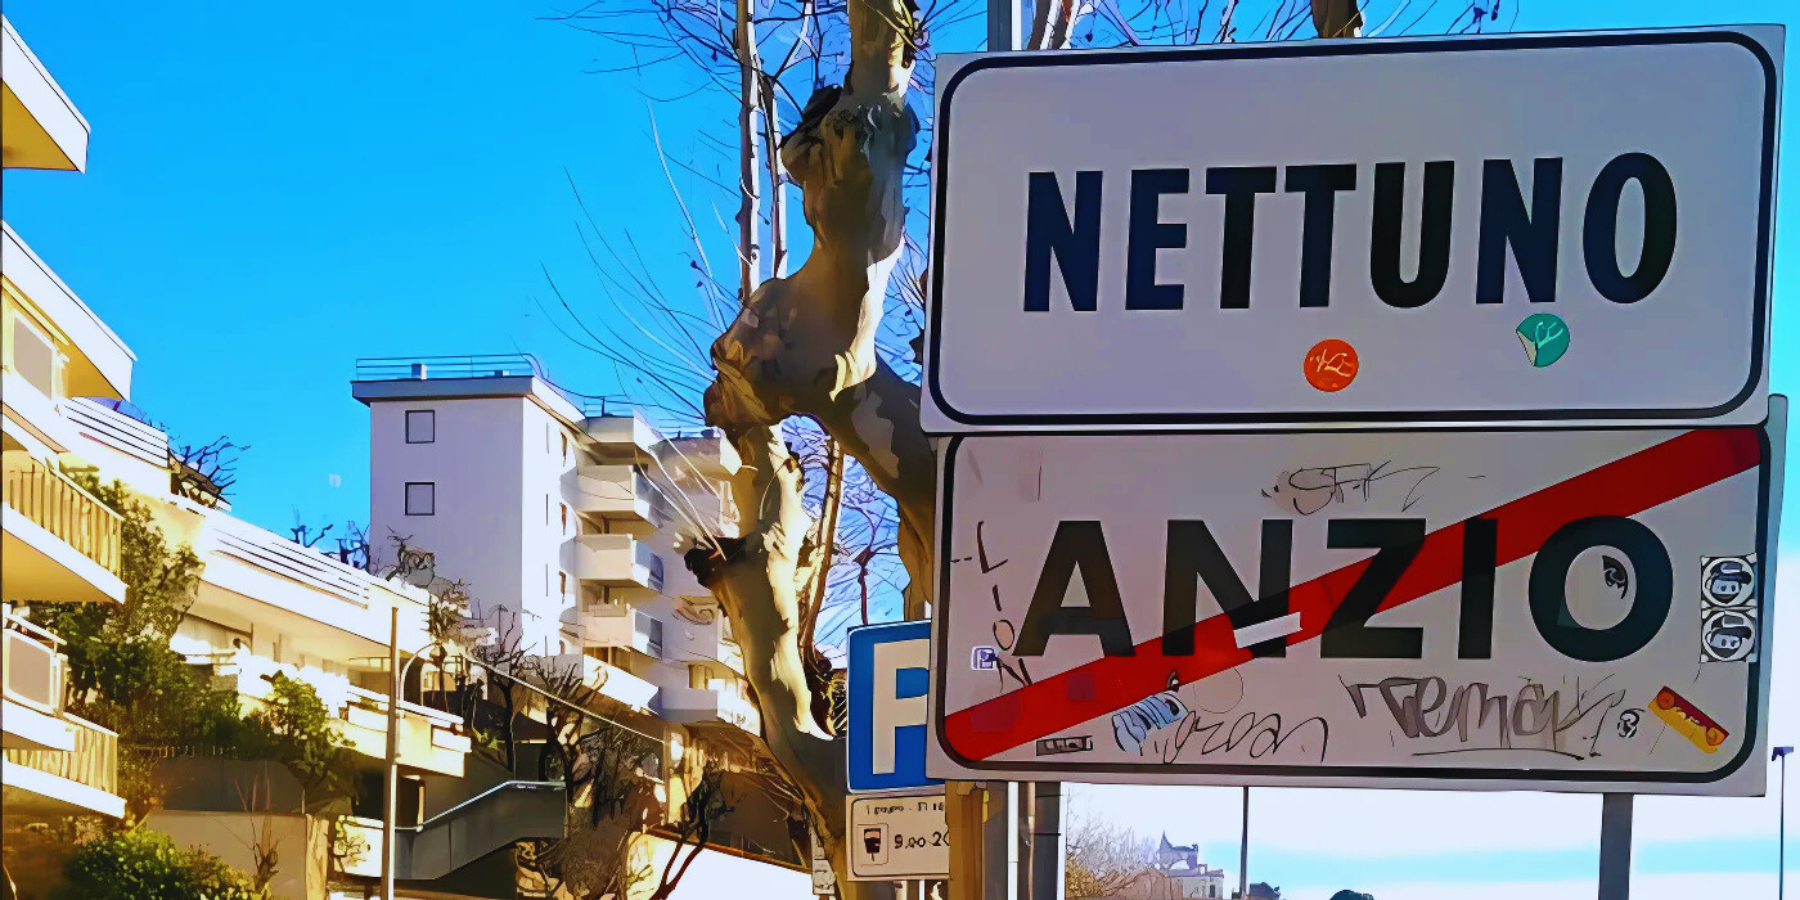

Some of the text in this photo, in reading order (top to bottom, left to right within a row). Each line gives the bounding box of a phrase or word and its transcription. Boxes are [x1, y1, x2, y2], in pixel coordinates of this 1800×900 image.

[1023, 152, 1677, 312] NETTUNO
[1011, 512, 1674, 663] ANZIO
[872, 638, 931, 774] P
